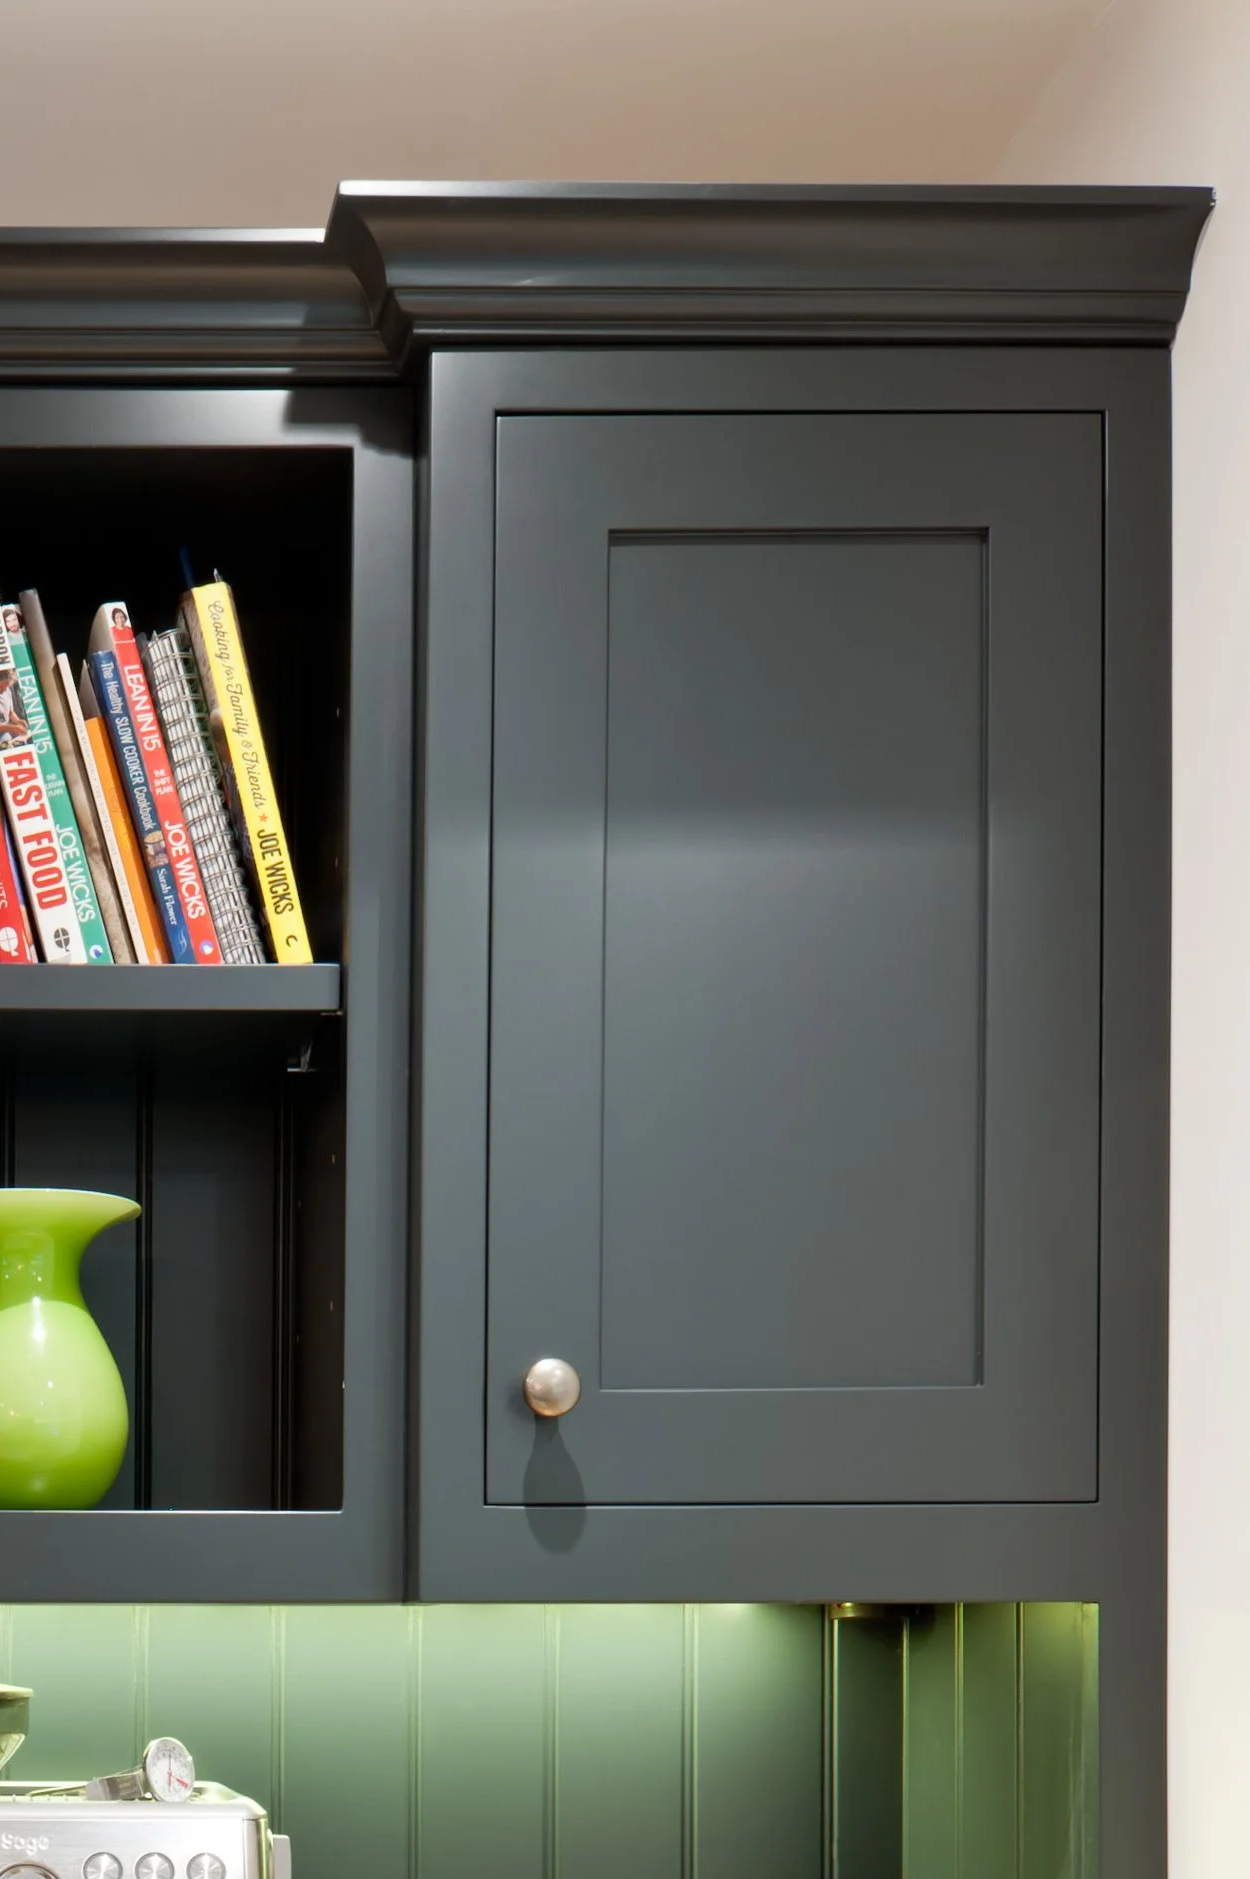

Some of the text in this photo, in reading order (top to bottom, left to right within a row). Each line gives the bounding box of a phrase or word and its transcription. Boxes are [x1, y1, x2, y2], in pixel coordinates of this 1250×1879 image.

[208, 600, 231, 660] Cooking
[224, 663, 234, 681] for
[16, 665, 53, 754] LEAN IN 15
[100, 662, 157, 831] The Healthy SLOW COOKER Cookbook
[123, 664, 161, 751] LEAN IN 15
[226, 683, 250, 735] Family
[242, 751, 264, 810] Friends
[3, 751, 68, 910] FAST FOOD
[55, 823, 95, 923] JOE WICKS
[165, 820, 205, 919] JOE WICKS
[257, 828, 294, 915] JOE WICKS
[156, 868, 177, 926] Sarah Flower
